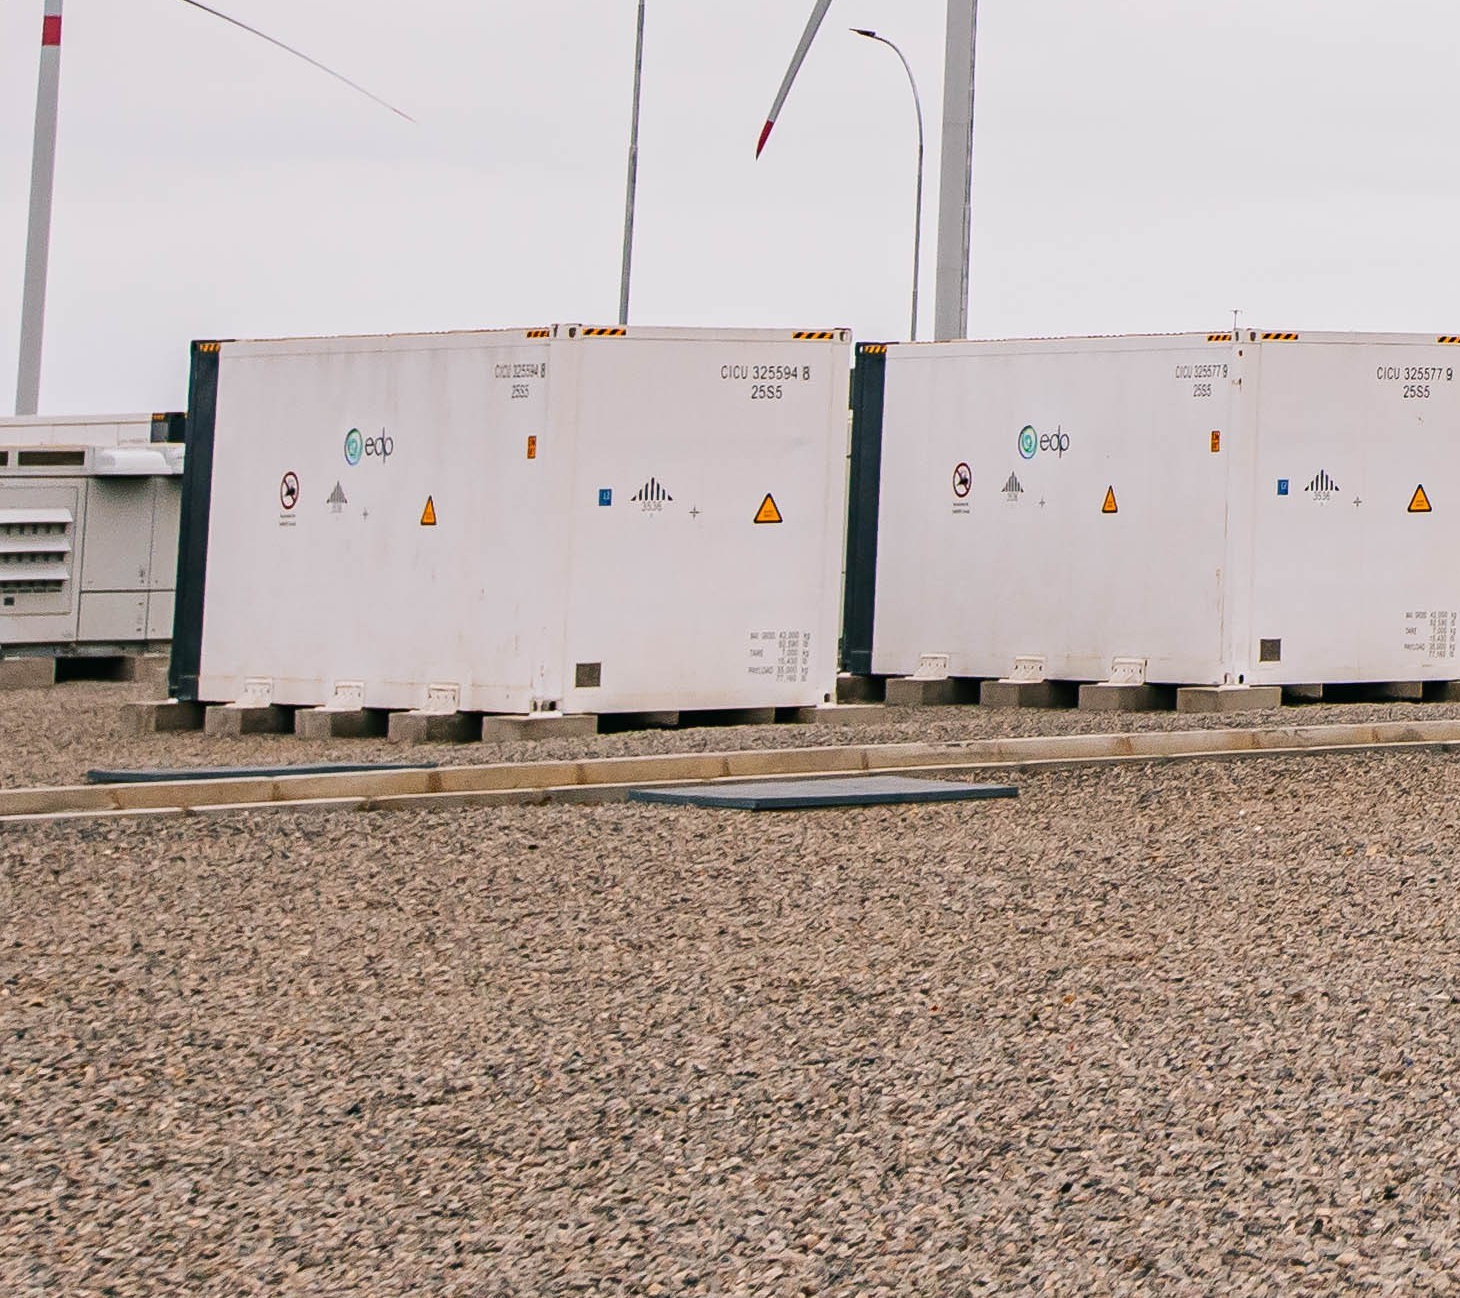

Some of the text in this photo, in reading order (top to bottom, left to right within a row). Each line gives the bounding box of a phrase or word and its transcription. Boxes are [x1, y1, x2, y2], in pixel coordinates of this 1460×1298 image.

[720, 365, 811, 381] CICU 325594 8
[1376, 366, 1453, 381] CICU 325577 9
[751, 385, 783, 400] 25S5
[1403, 385, 1431, 399] 25S5
[365, 427, 394, 464] edp
[1039, 424, 1070, 459] edp
